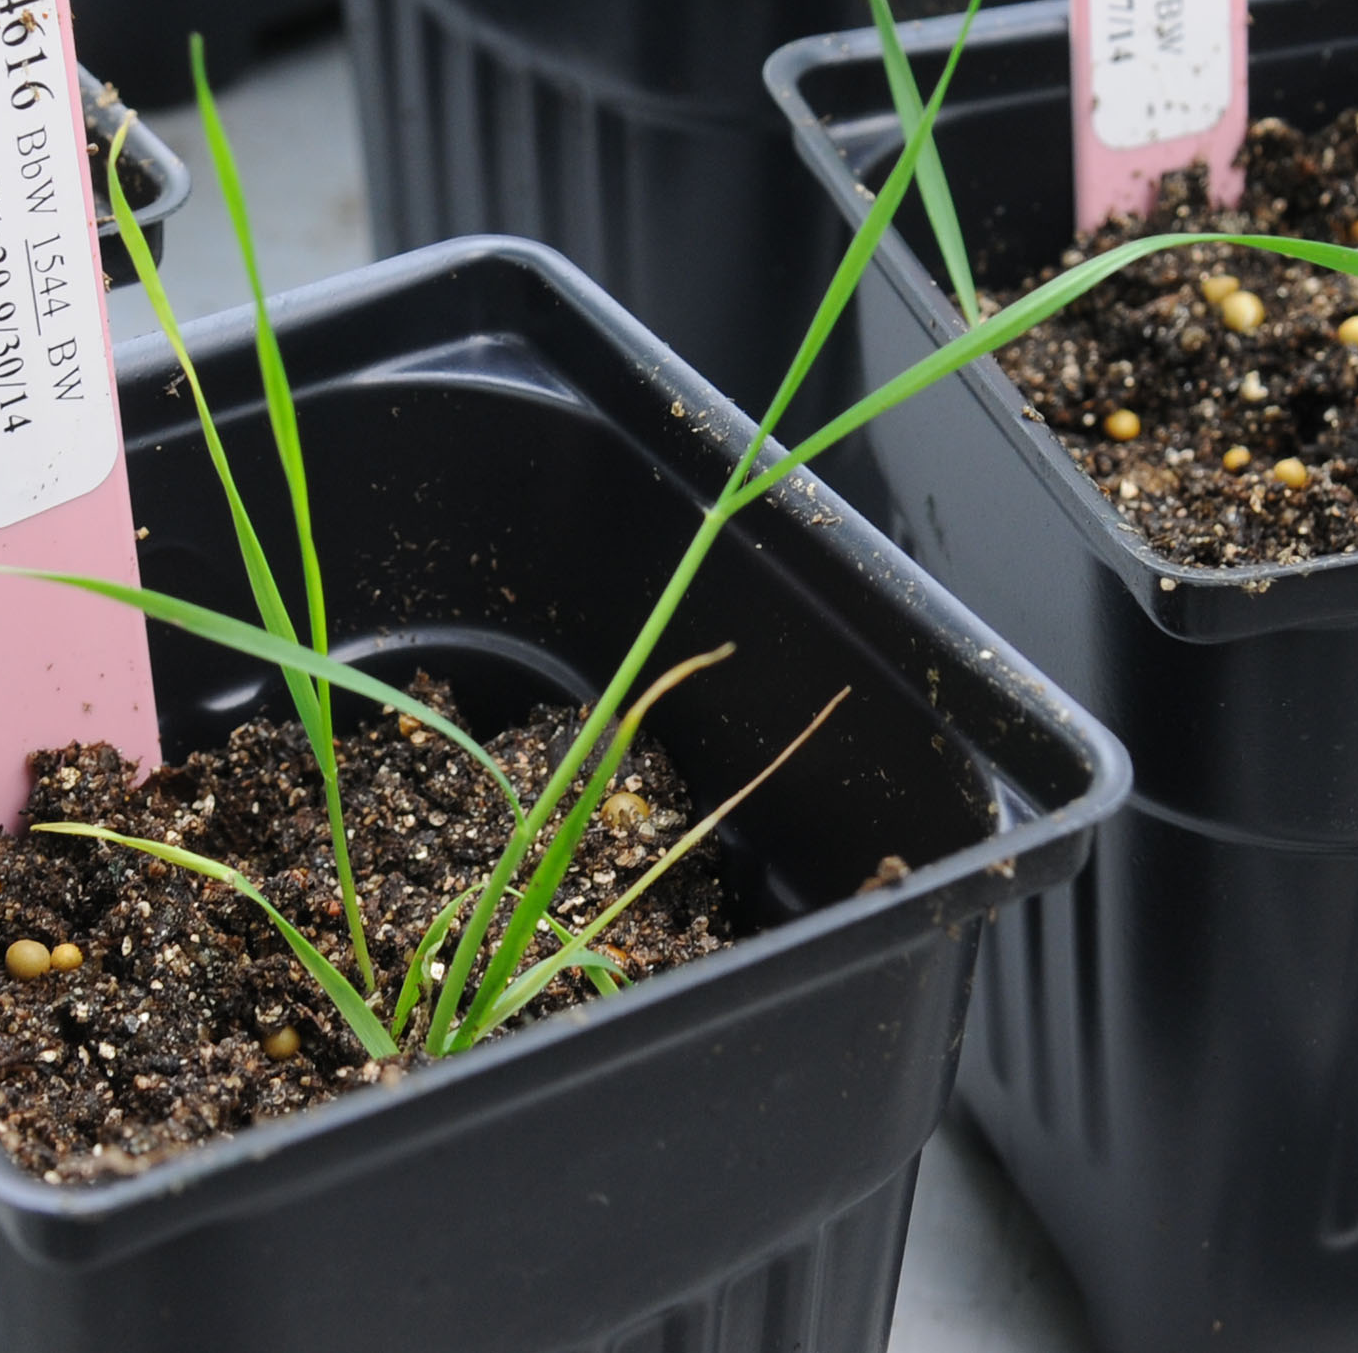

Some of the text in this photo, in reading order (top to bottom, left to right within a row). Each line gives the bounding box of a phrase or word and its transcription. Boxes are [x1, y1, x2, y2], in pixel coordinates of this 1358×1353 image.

[16, 126, 58, 216] BbW
[26, 234, 72, 335] 1544
[47, 336, 85, 403] BW
